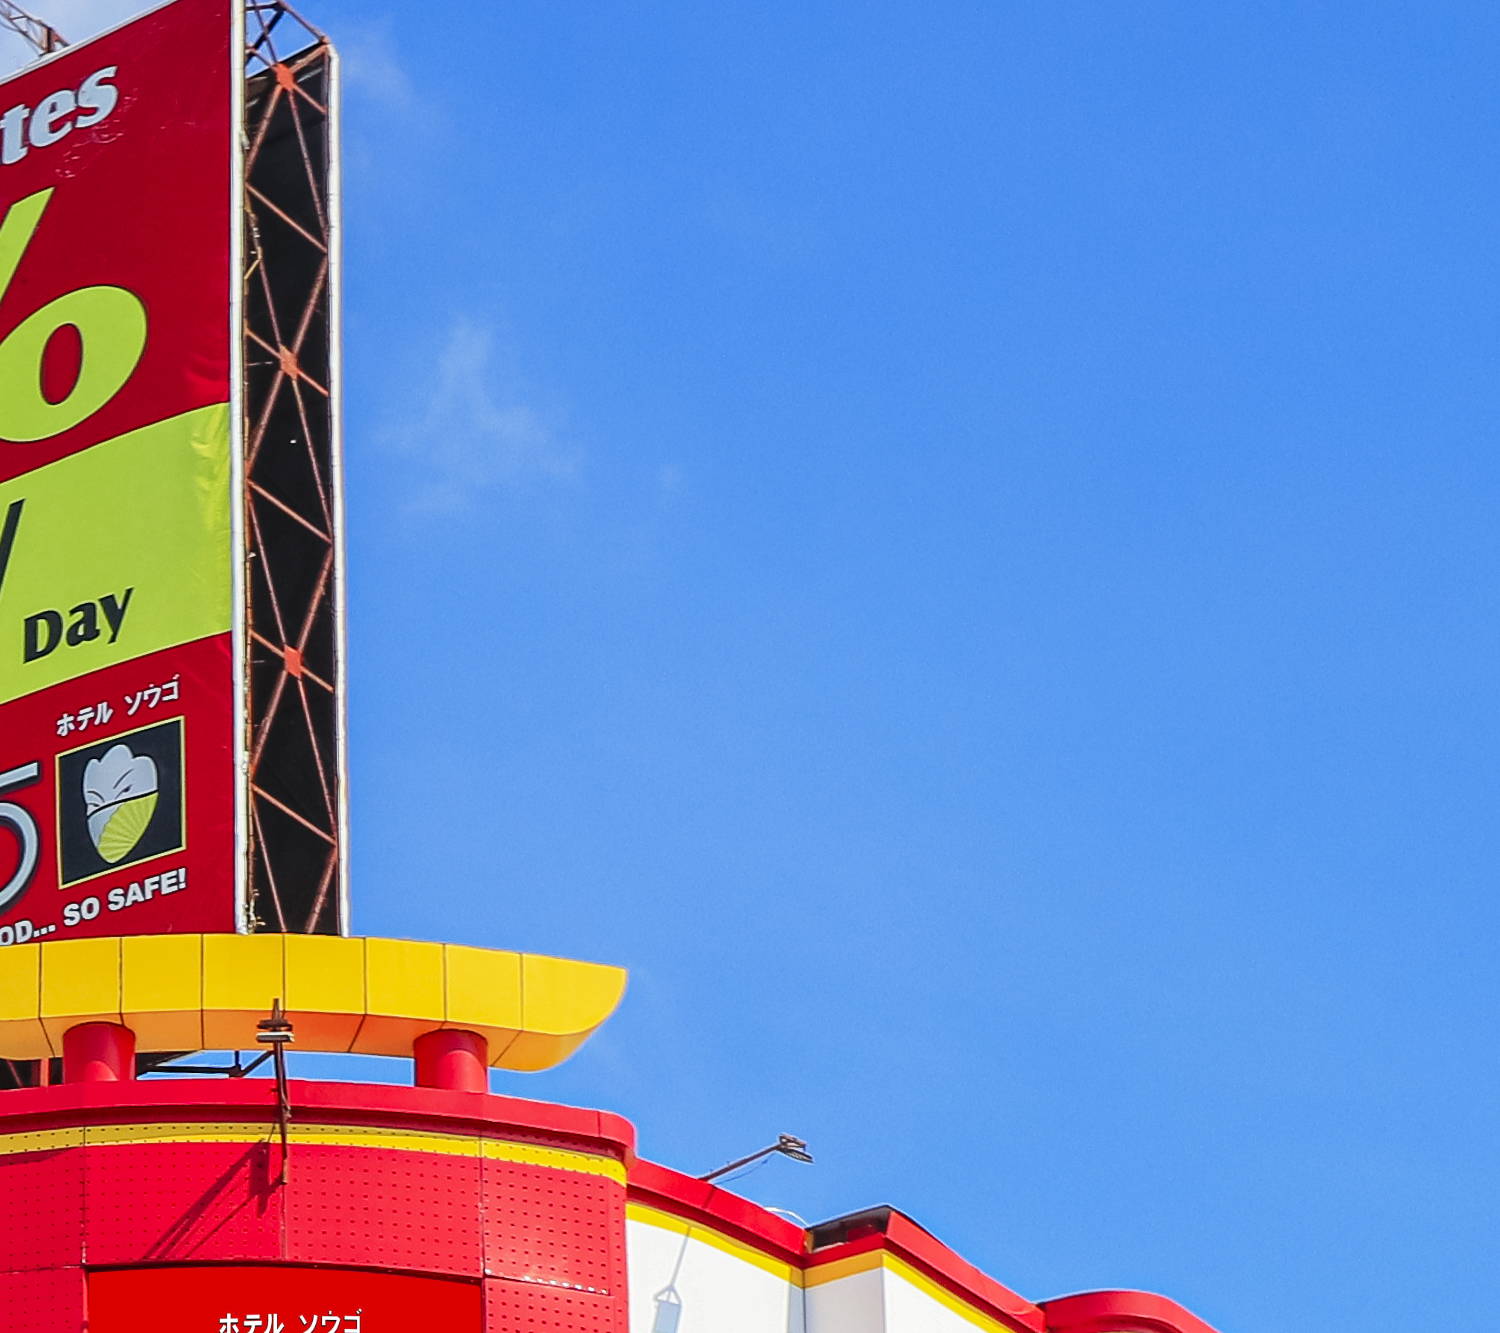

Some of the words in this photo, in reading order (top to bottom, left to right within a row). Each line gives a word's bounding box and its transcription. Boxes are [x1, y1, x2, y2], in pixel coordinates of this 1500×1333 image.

[56, 702, 113, 737] ホテル
[64, 897, 100, 927] SO
[108, 867, 188, 912] SAFE!
